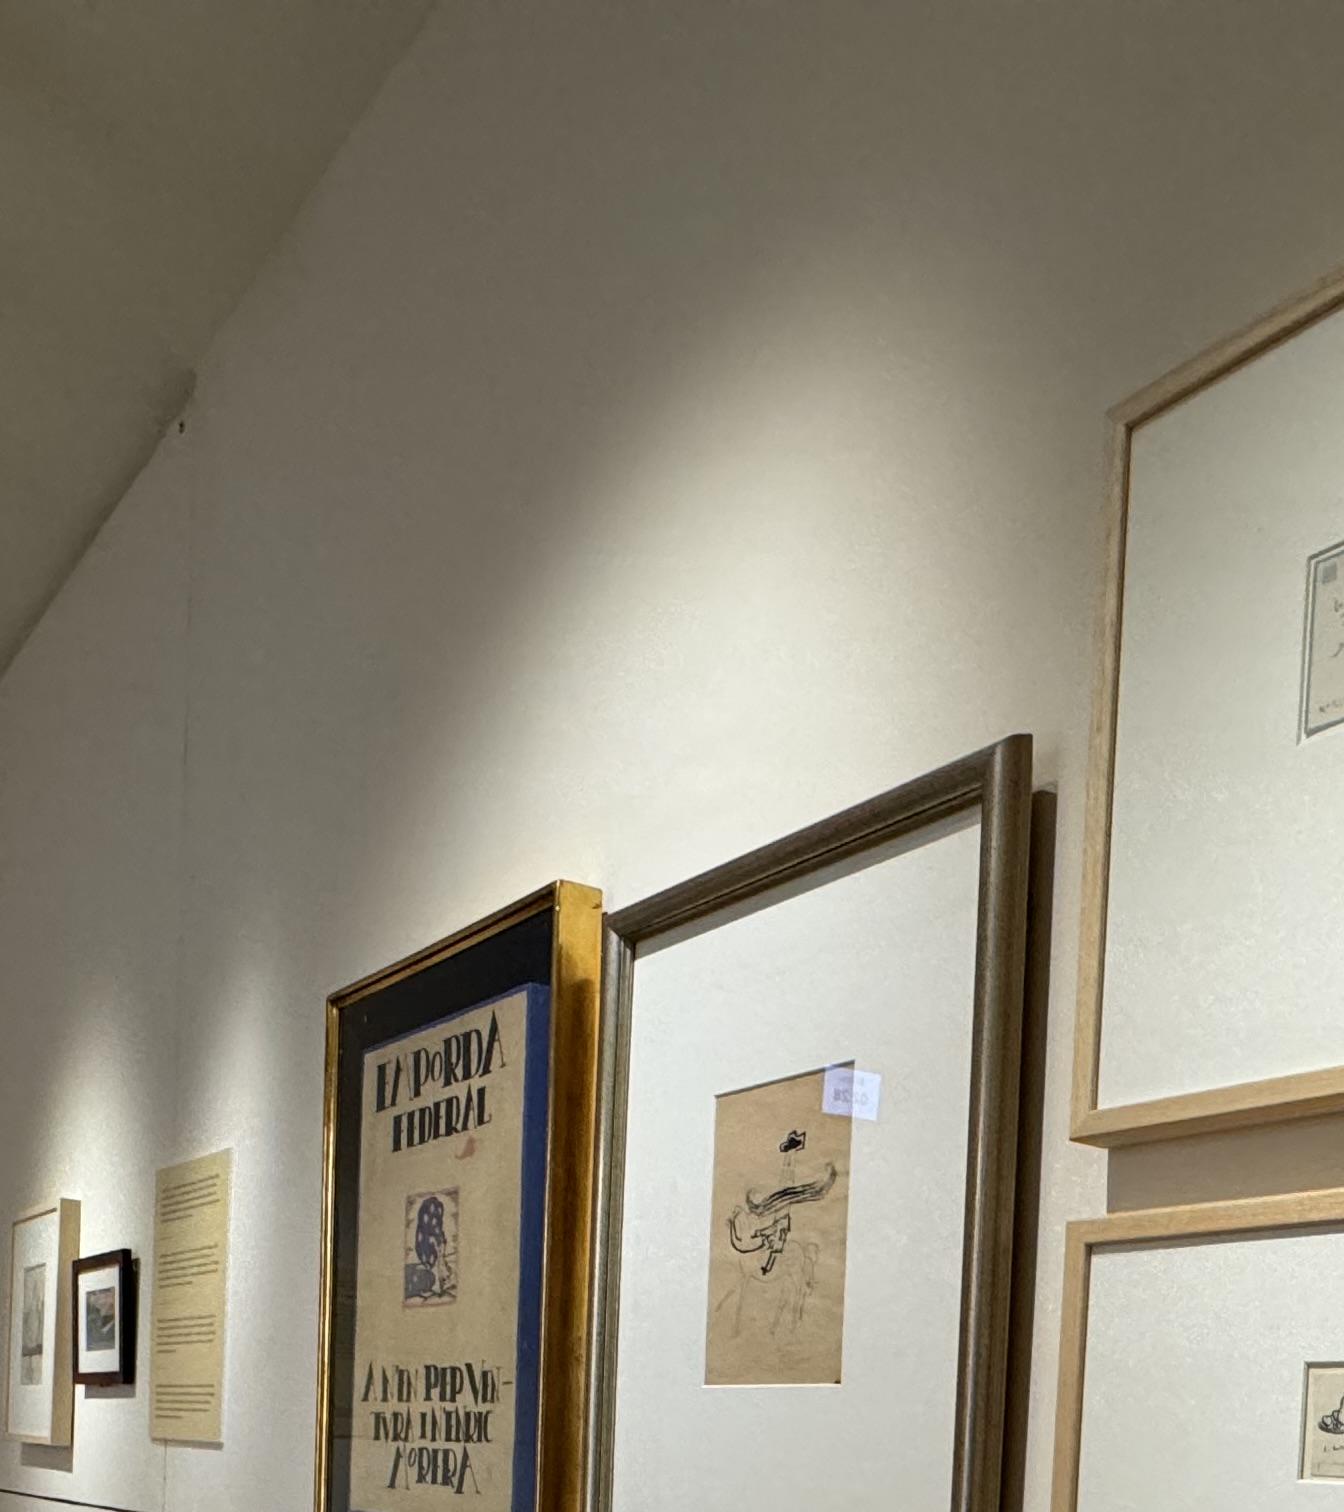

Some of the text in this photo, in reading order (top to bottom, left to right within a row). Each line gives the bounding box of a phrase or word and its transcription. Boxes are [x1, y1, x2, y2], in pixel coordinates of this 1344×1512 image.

[392, 1082, 493, 1153] FEDERAL
[360, 1361, 377, 1402] A
[423, 1364, 464, 1403] PEP
